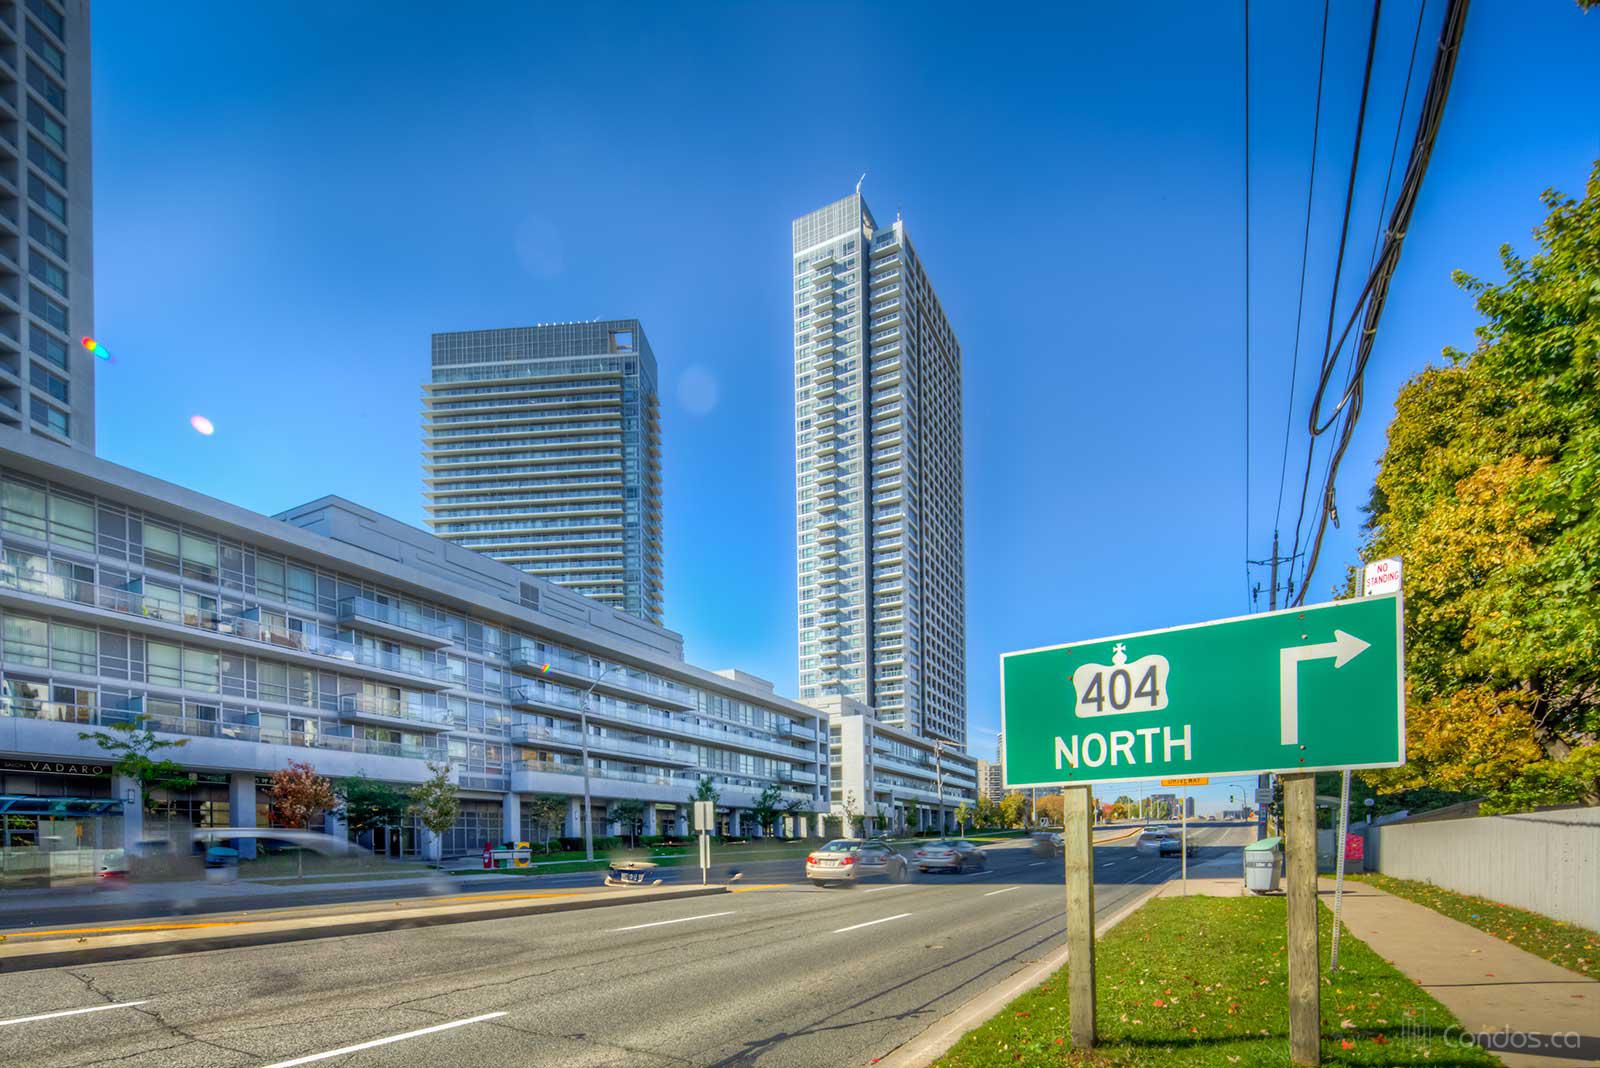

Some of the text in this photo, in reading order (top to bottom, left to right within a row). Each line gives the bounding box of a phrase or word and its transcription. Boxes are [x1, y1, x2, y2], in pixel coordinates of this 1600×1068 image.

[1376, 563, 1388, 573] NO
[1367, 571, 1399, 588] STANDING
[1081, 665, 1160, 712] 404
[1054, 724, 1192, 770] NORTH
[31, 762, 103, 775] VADARO
